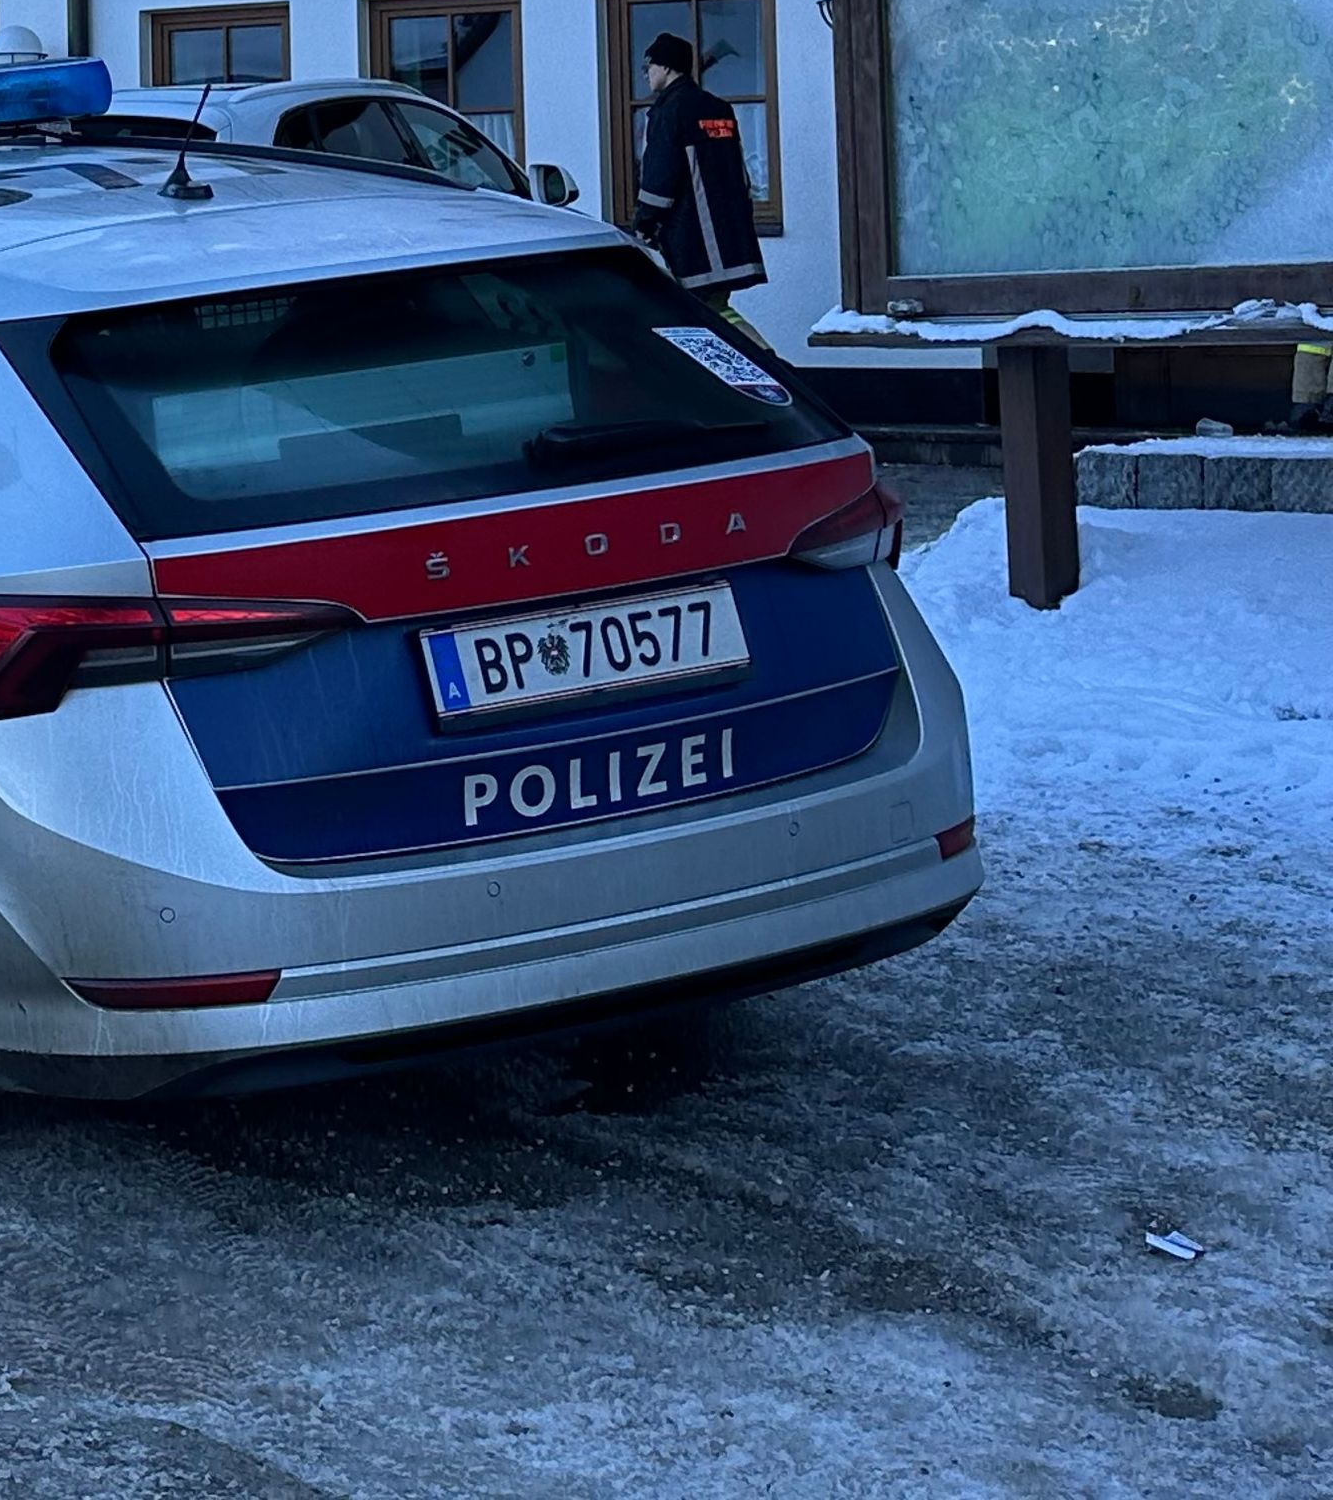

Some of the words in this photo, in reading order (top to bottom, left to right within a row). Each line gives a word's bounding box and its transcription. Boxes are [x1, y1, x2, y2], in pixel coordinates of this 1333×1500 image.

[448, 682, 461, 699] A
[475, 632, 532, 694] BP
[569, 601, 711, 678] 70577
[464, 728, 734, 826] POLIZEI
